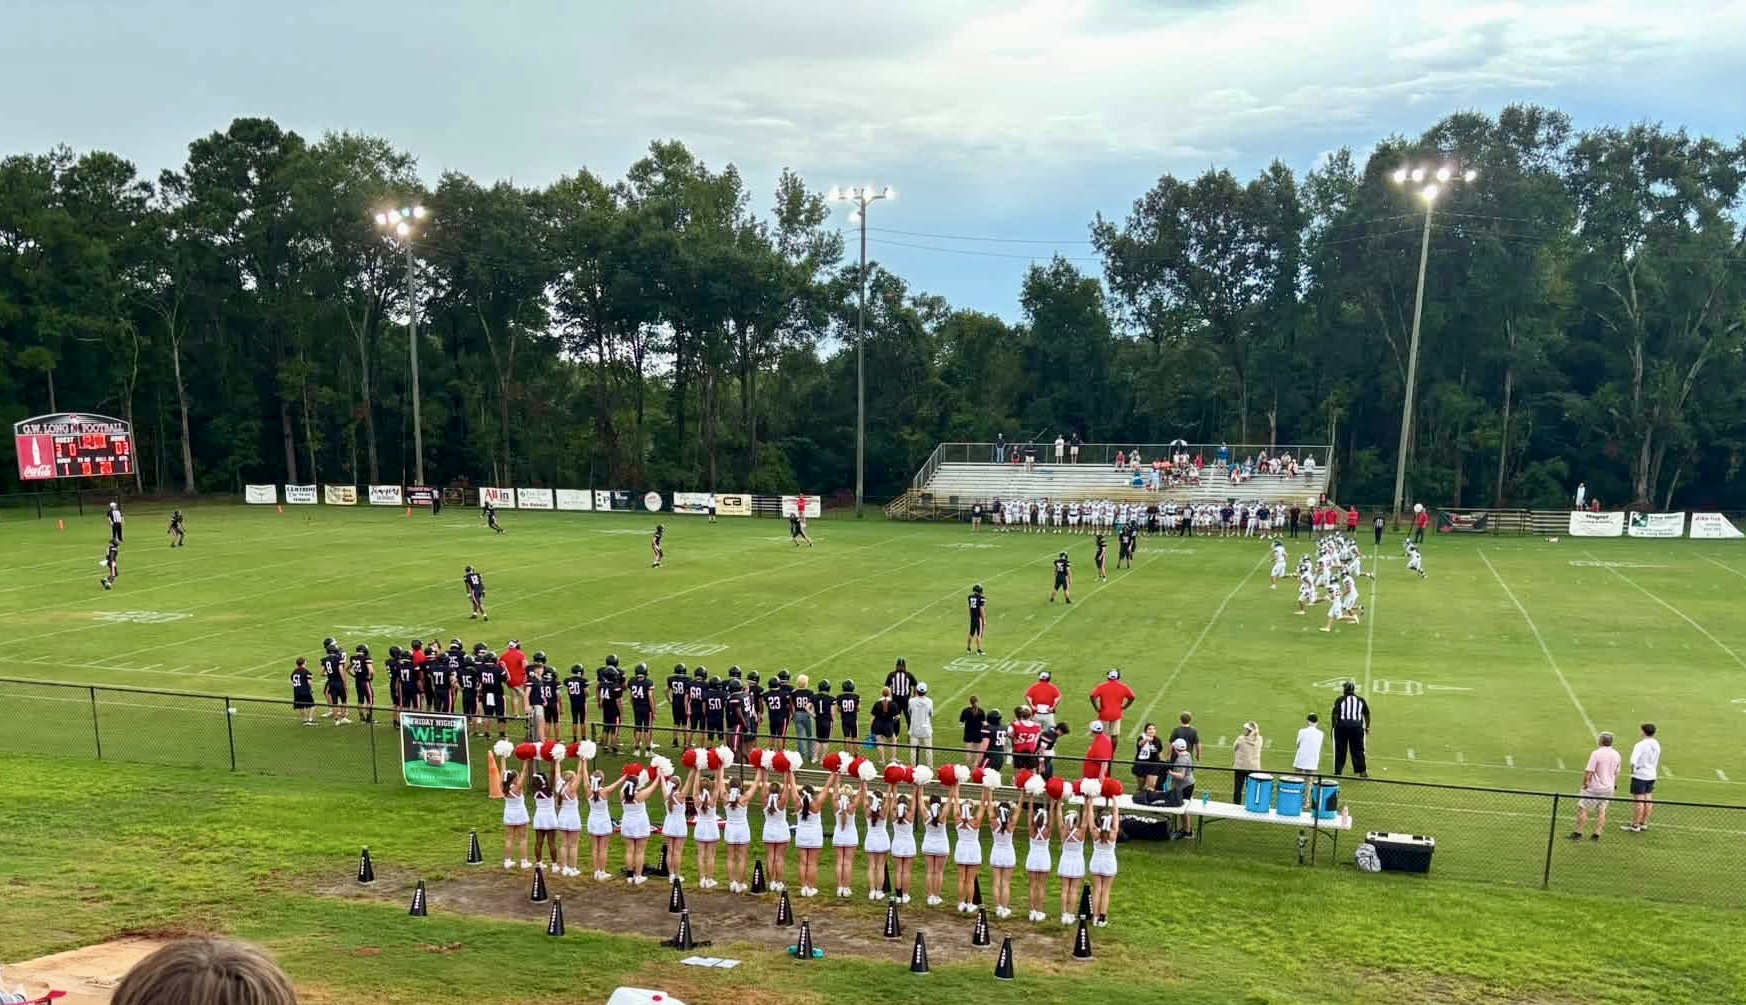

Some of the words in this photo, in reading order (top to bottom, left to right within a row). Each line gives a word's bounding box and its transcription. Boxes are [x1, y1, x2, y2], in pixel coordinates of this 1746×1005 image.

[44, 424, 69, 434] LONG
[82, 423, 125, 434] FOOTBALL
[486, 489, 498, 501] All
[500, 491, 509, 500] in
[943, 657, 1046, 673] 50
[293, 674, 302, 687] 51
[433, 671, 444, 685] 77
[462, 675, 472, 688] 15
[482, 672, 494, 685] 60
[568, 682, 580, 695] 20
[632, 685, 644, 699] 24
[672, 681, 684, 694] 58
[709, 698, 722, 710] 50
[768, 696, 780, 709] 23
[411, 727, 457, 744] Wi-Fi
